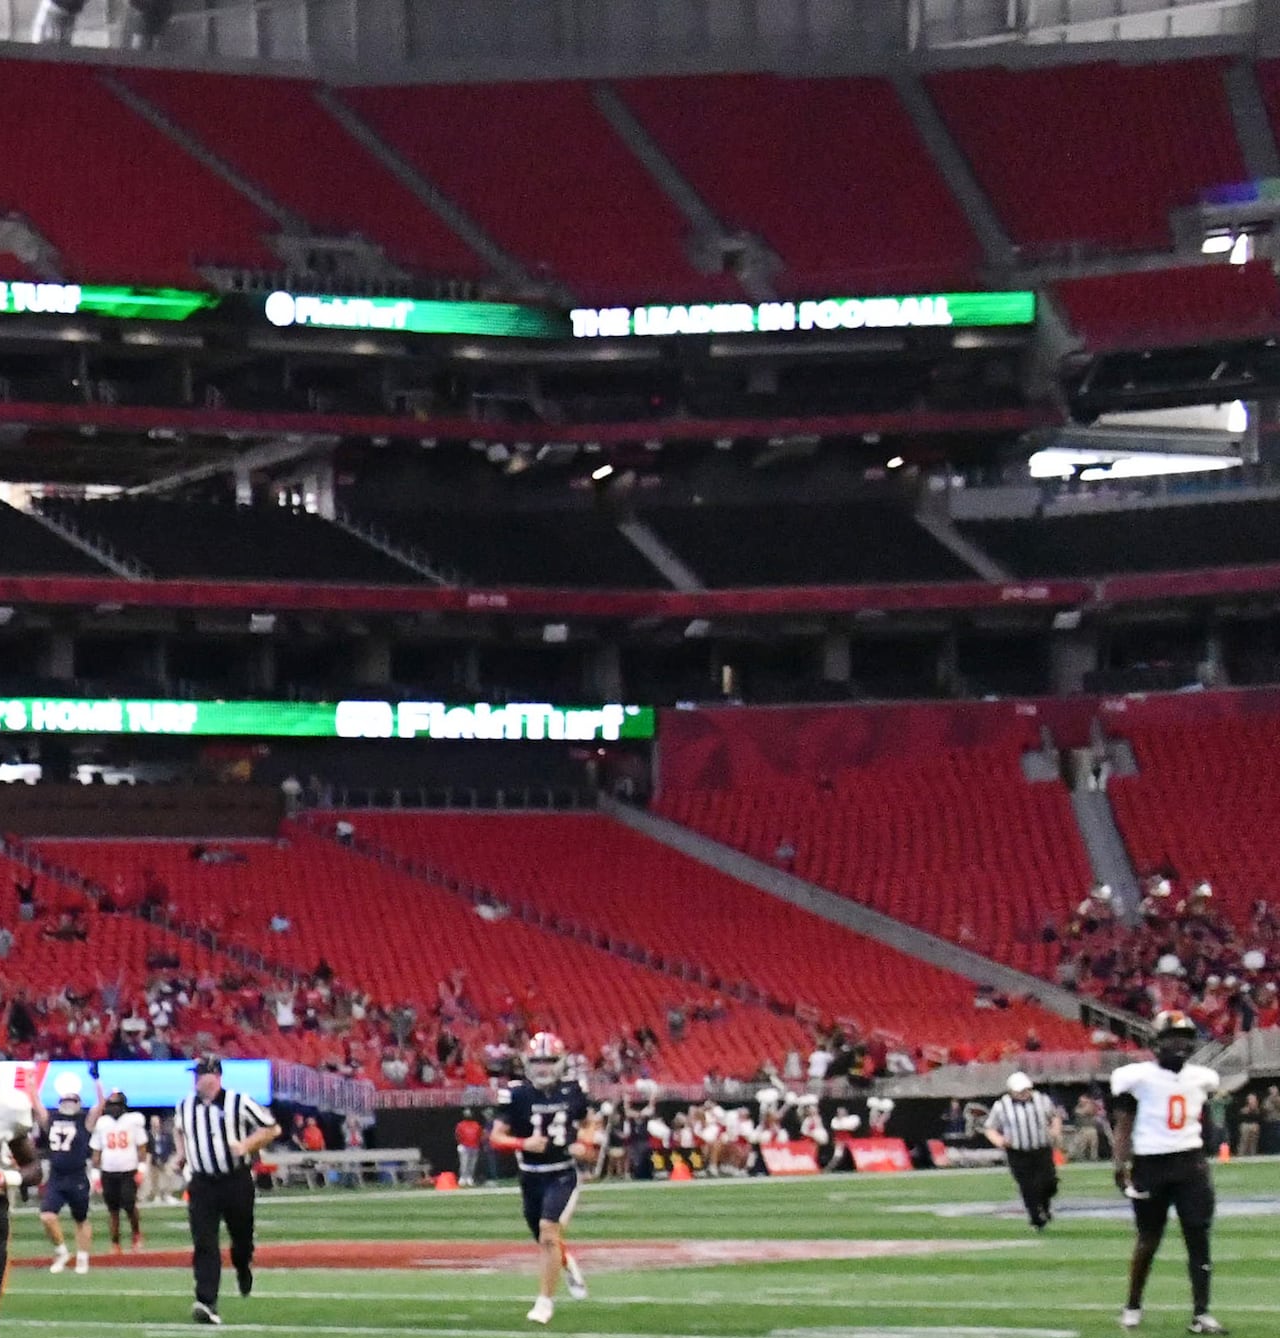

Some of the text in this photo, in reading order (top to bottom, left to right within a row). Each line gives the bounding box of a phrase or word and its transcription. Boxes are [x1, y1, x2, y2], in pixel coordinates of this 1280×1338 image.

[11, 282, 82, 313] TURF
[570, 297, 953, 337] THE LEADER IN FOOTBALL
[32, 701, 123, 732] HOME
[125, 702, 198, 733] TURF
[396, 700, 625, 740] FieldTurf
[1167, 1094, 1187, 1130] 0
[48, 1124, 77, 1152] 57
